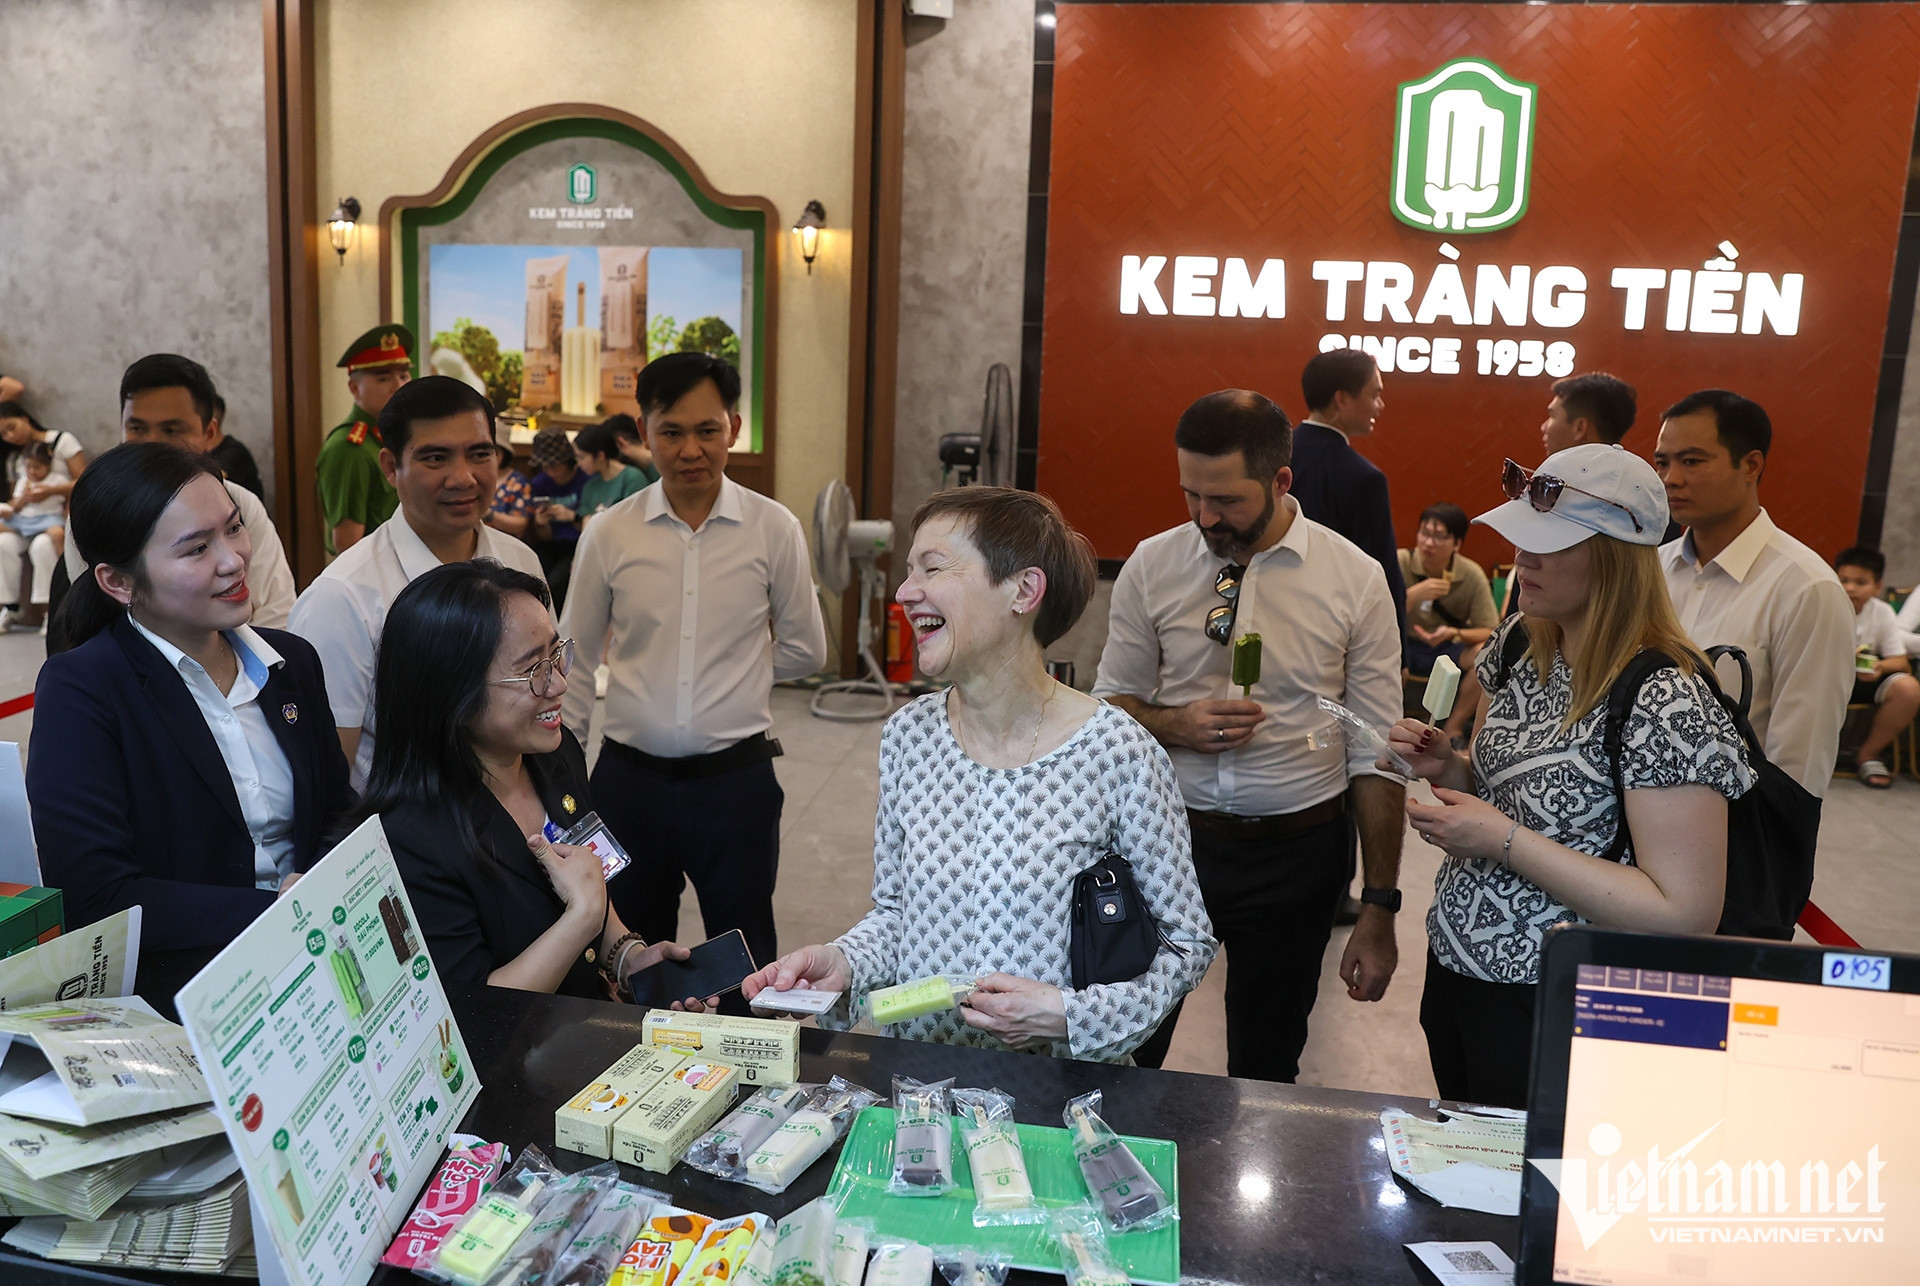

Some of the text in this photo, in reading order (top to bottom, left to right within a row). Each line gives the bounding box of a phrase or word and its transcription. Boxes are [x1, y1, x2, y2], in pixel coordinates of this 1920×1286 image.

[529, 207, 556, 219] KEM
[1118, 241, 1804, 337] KEM TRÀNG TIỀN
[1477, 338, 1577, 378] 1958
[412, 961, 423, 978] 30
[627, 1241, 669, 1257] TÂY
